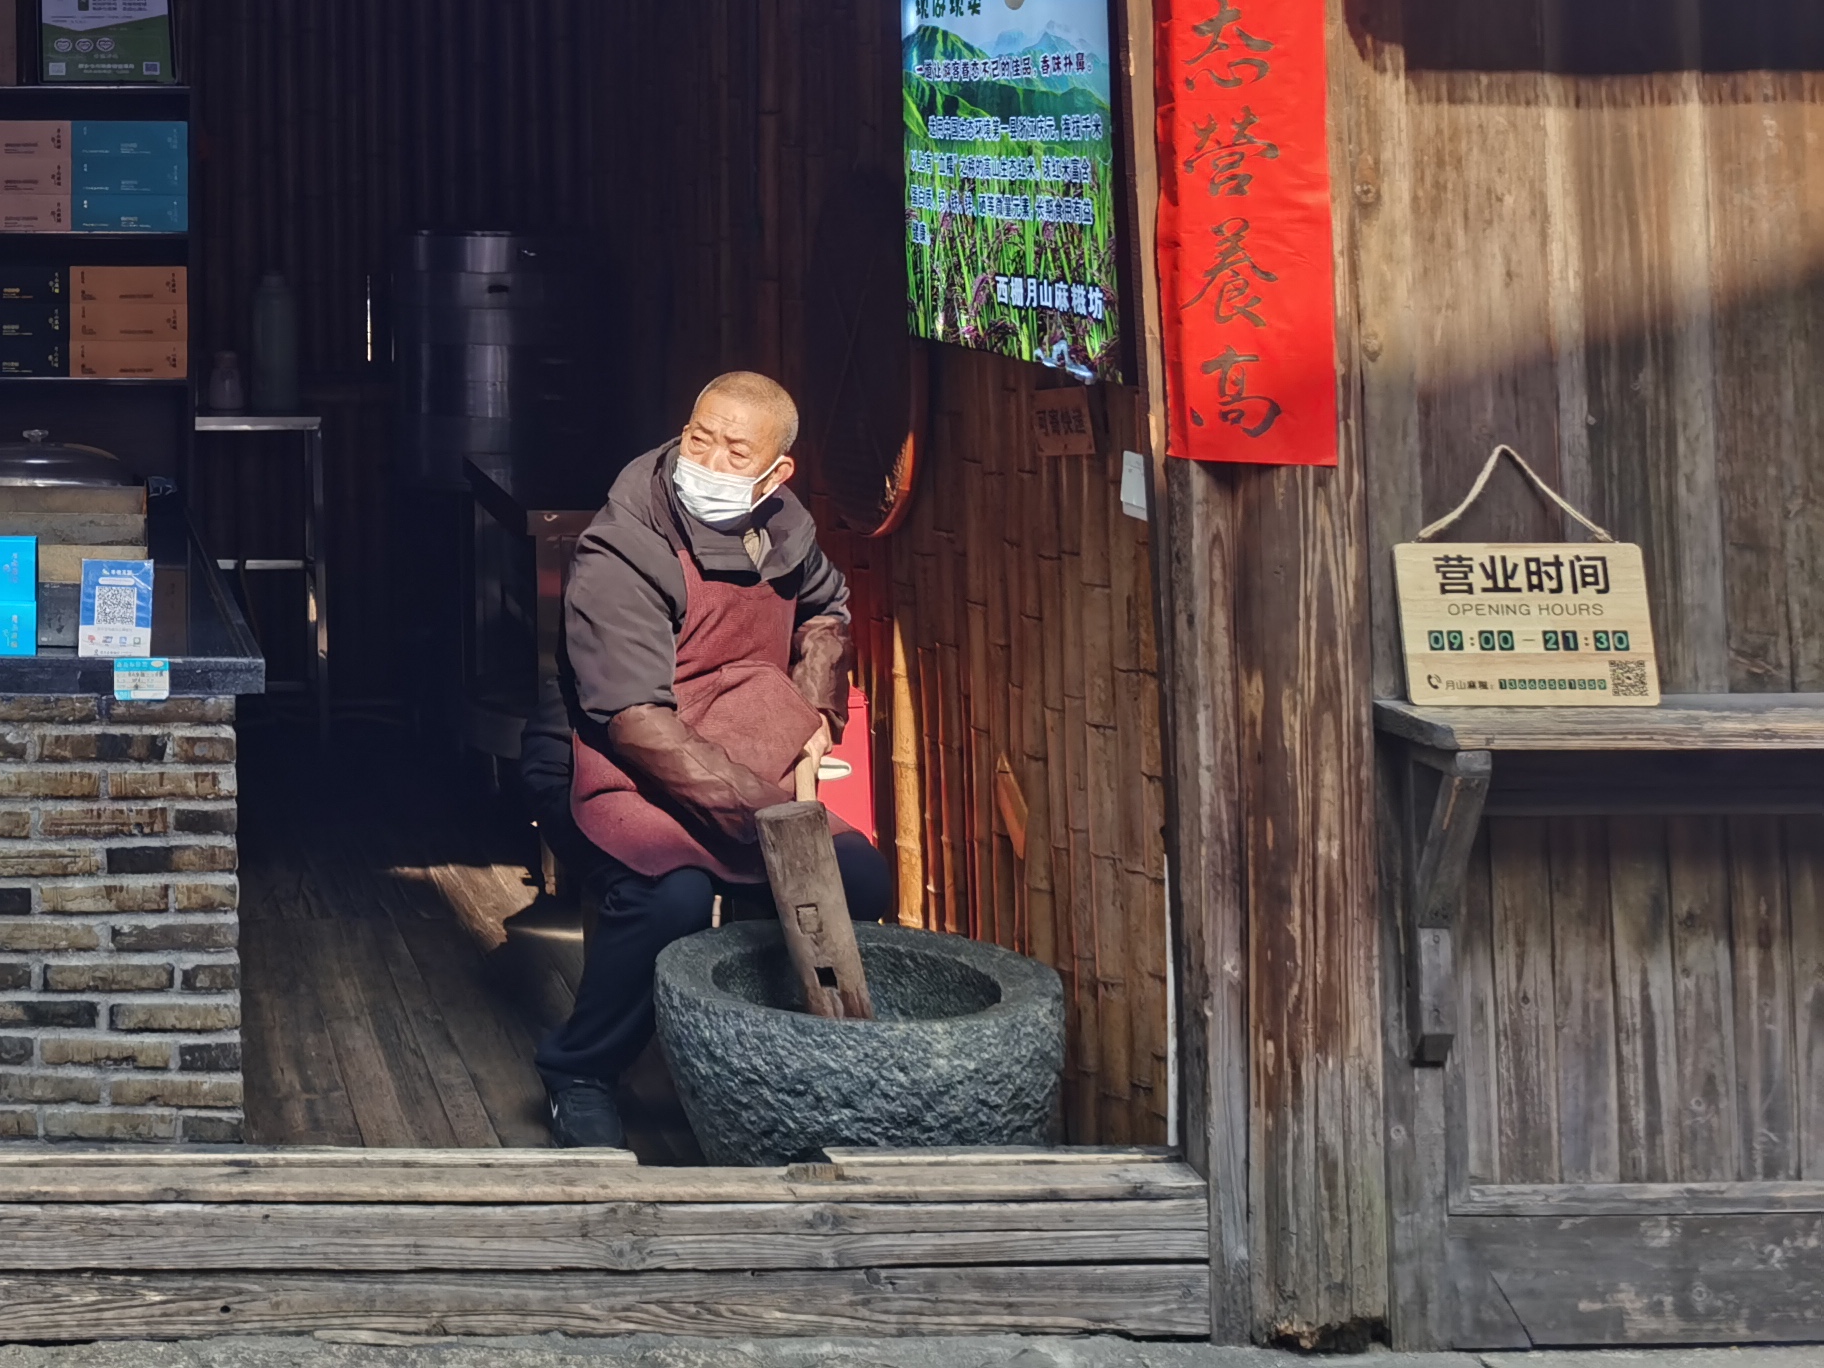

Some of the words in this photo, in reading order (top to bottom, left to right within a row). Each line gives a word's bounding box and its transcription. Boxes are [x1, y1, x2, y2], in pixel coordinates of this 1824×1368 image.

[995, 275, 1103, 320] 西栅月山麻糍坊
[1433, 554, 1611, 595] 营业时间
[1447, 603, 1531, 616] OPENING
[1538, 603, 1604, 616] HOURS
[1428, 630, 1515, 651] 09:00
[1542, 630, 1630, 651] 21:30
